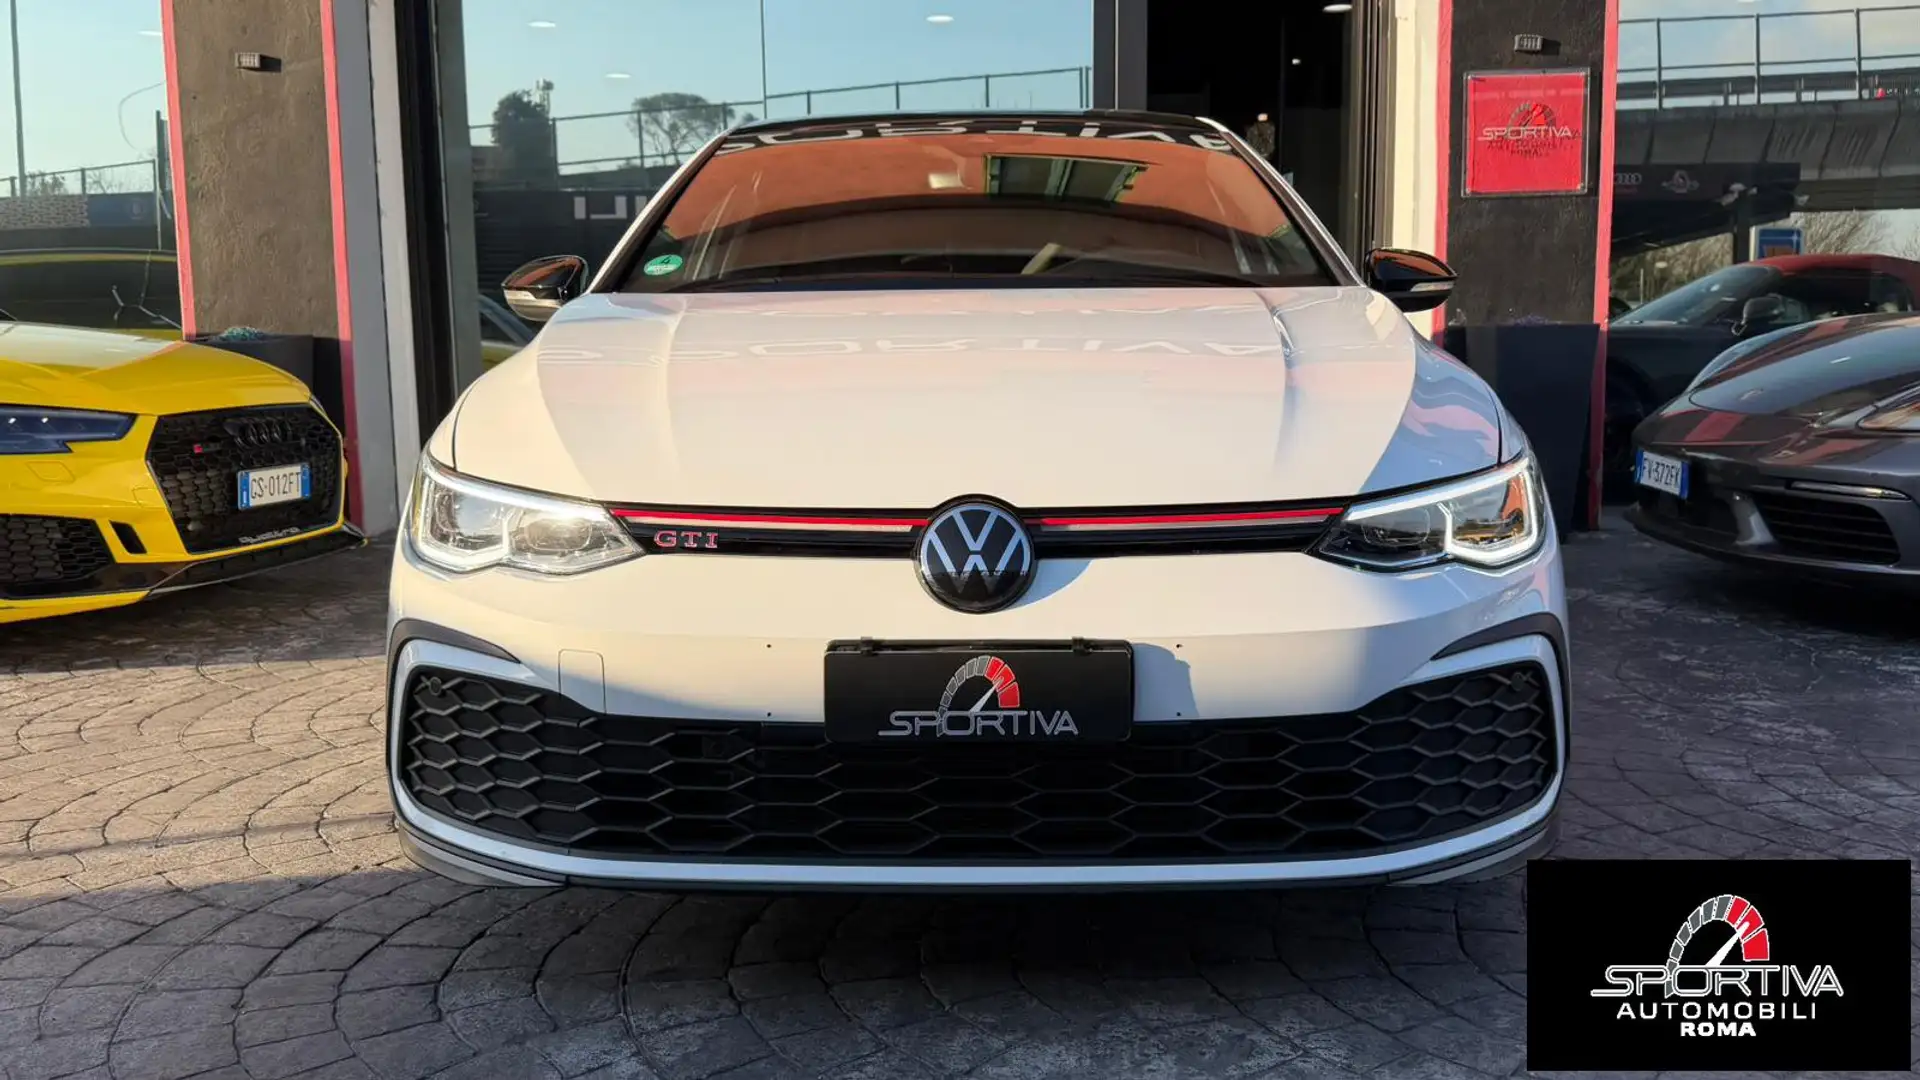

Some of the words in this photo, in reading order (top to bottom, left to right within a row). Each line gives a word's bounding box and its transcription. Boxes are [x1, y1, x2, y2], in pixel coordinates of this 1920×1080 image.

[1477, 125, 1572, 141] SPORTIVA
[653, 529, 719, 549] GTI
[878, 710, 1079, 736] SPORTIVA
